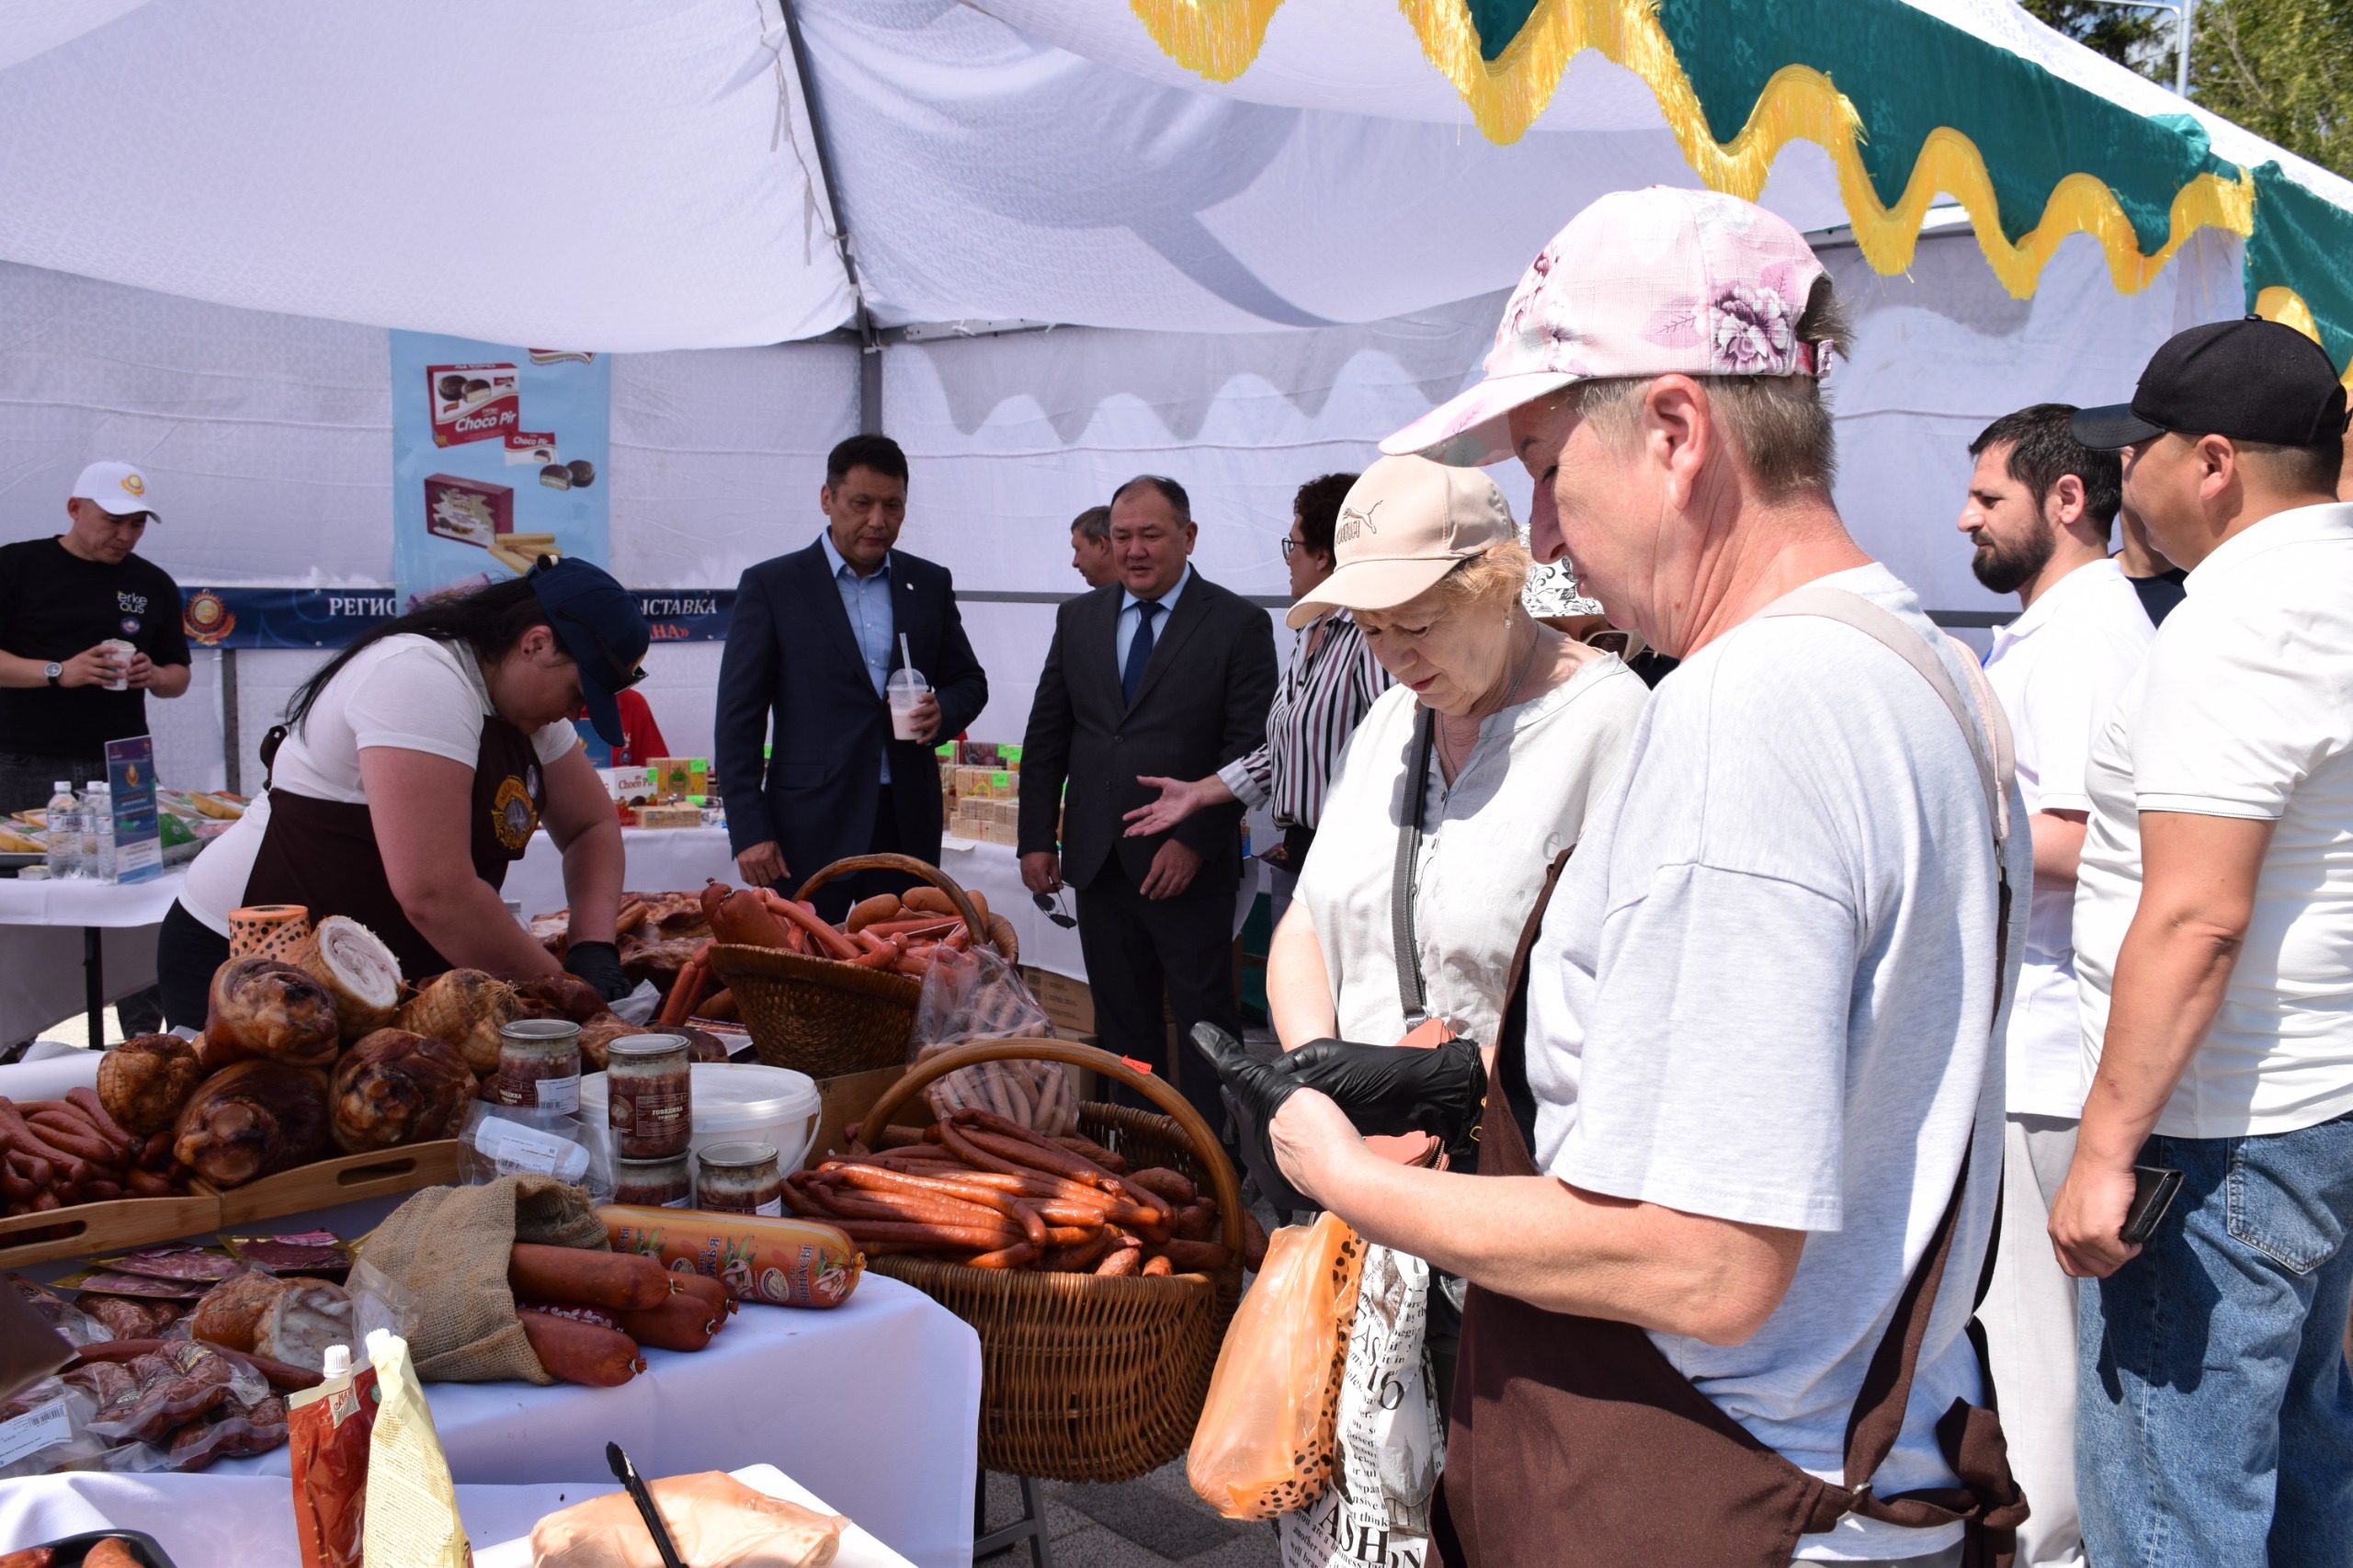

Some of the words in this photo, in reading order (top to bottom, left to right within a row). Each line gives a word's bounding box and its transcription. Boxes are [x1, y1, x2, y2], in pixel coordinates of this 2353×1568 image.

[455, 415, 497, 432] Choco
[499, 410, 517, 426] Pir
[513, 436, 537, 446] Choco
[650, 623, 689, 640] НА»
[619, 778, 642, 790] Choco
[706, 1236, 722, 1278] ЖЬЯ
[1360, 1511, 1389, 1528] think
[1292, 1526, 1318, 1552] another
